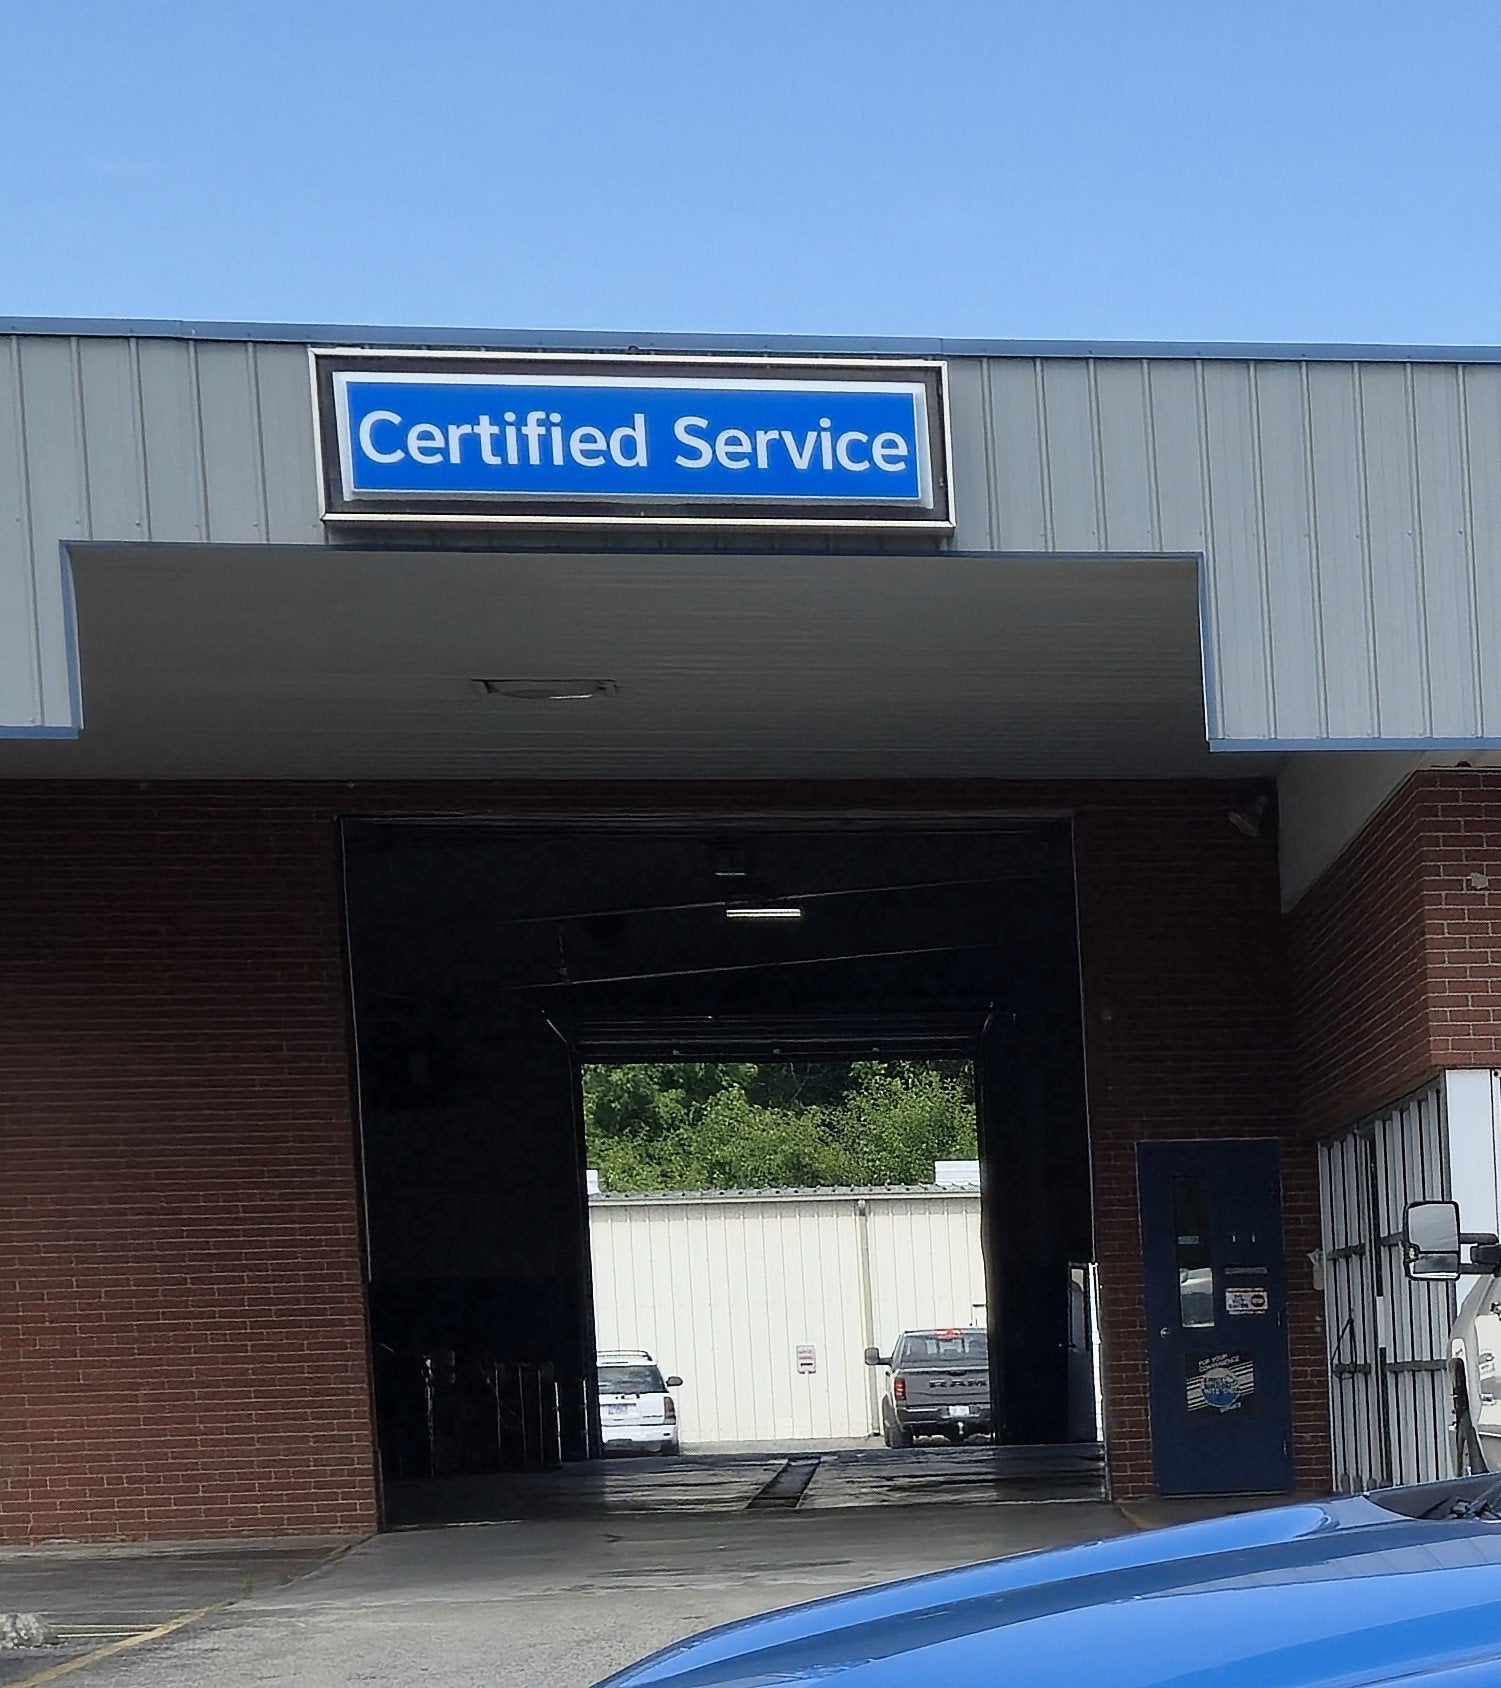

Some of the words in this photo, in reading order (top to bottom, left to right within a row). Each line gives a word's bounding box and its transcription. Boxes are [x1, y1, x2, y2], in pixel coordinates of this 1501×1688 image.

[358, 409, 648, 468] Certified
[674, 415, 908, 473] Service
[928, 1379, 988, 1389] RAM
